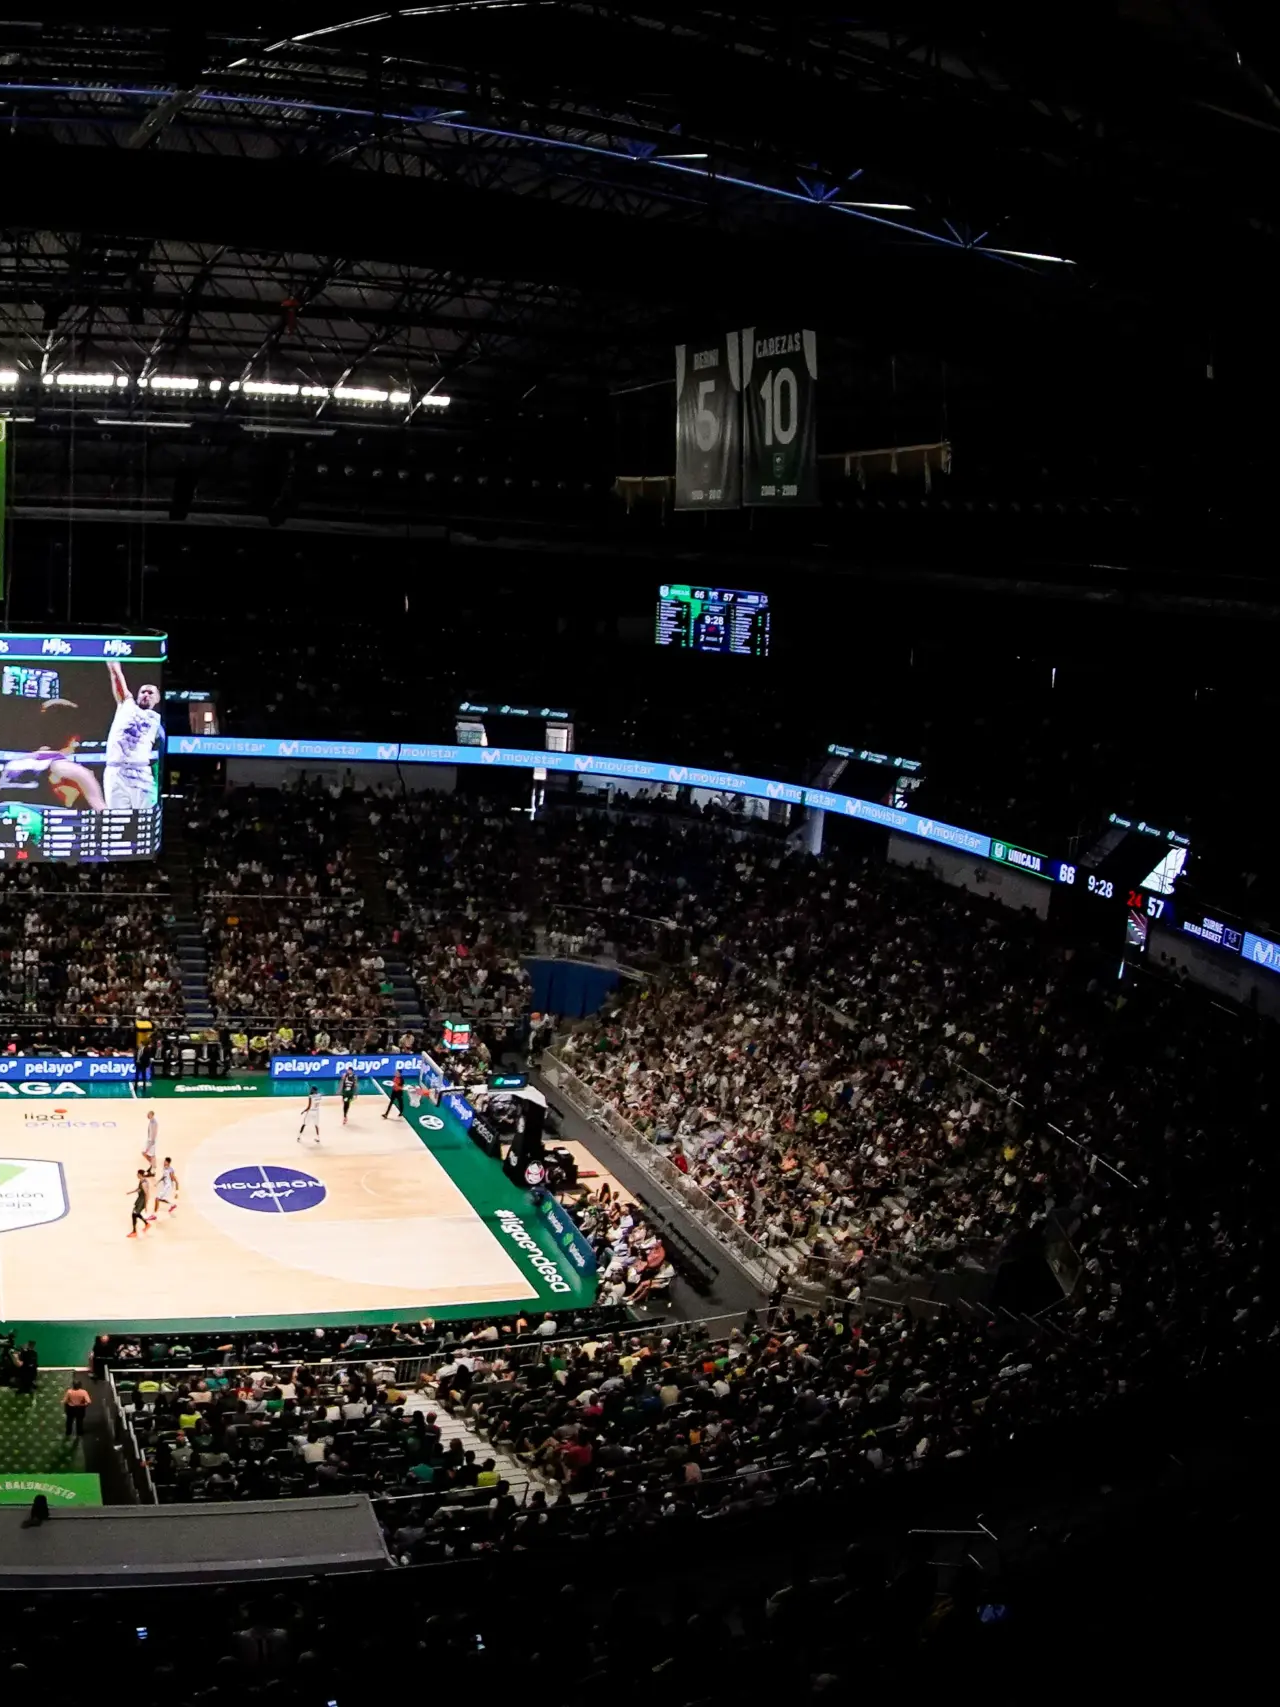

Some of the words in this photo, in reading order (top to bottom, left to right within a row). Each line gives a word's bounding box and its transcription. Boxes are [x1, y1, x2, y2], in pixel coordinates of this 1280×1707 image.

[755, 332, 801, 359] CABEZAS
[695, 379, 719, 451] 5
[760, 367, 798, 446] 10
[694, 591, 705, 599] 66
[723, 593, 734, 602] 57
[705, 615, 724, 625] 9:28
[203, 742, 266, 752] movistar
[301, 744, 362, 756] movistar
[502, 752, 561, 765] movistar
[595, 759, 655, 774] movistar
[689, 772, 747, 789] movistar
[861, 805, 908, 826] movistar
[934, 826, 981, 848] movistar
[1008, 849, 1040, 871] UNICAJA
[1060, 863, 1075, 884] 66
[1088, 875, 1113, 898] 9:28
[1127, 890, 1143, 908] 24
[1147, 896, 1164, 918] 57
[25, 1061, 73, 1077] pelayo
[274, 1059, 320, 1075] pelayo
[335, 1058, 381, 1075] pelayo
[25, 1113, 64, 1121] liga
[494, 1209, 572, 1293] #ligaendesa
[5, 1481, 76, 1500] BALONCESTO
